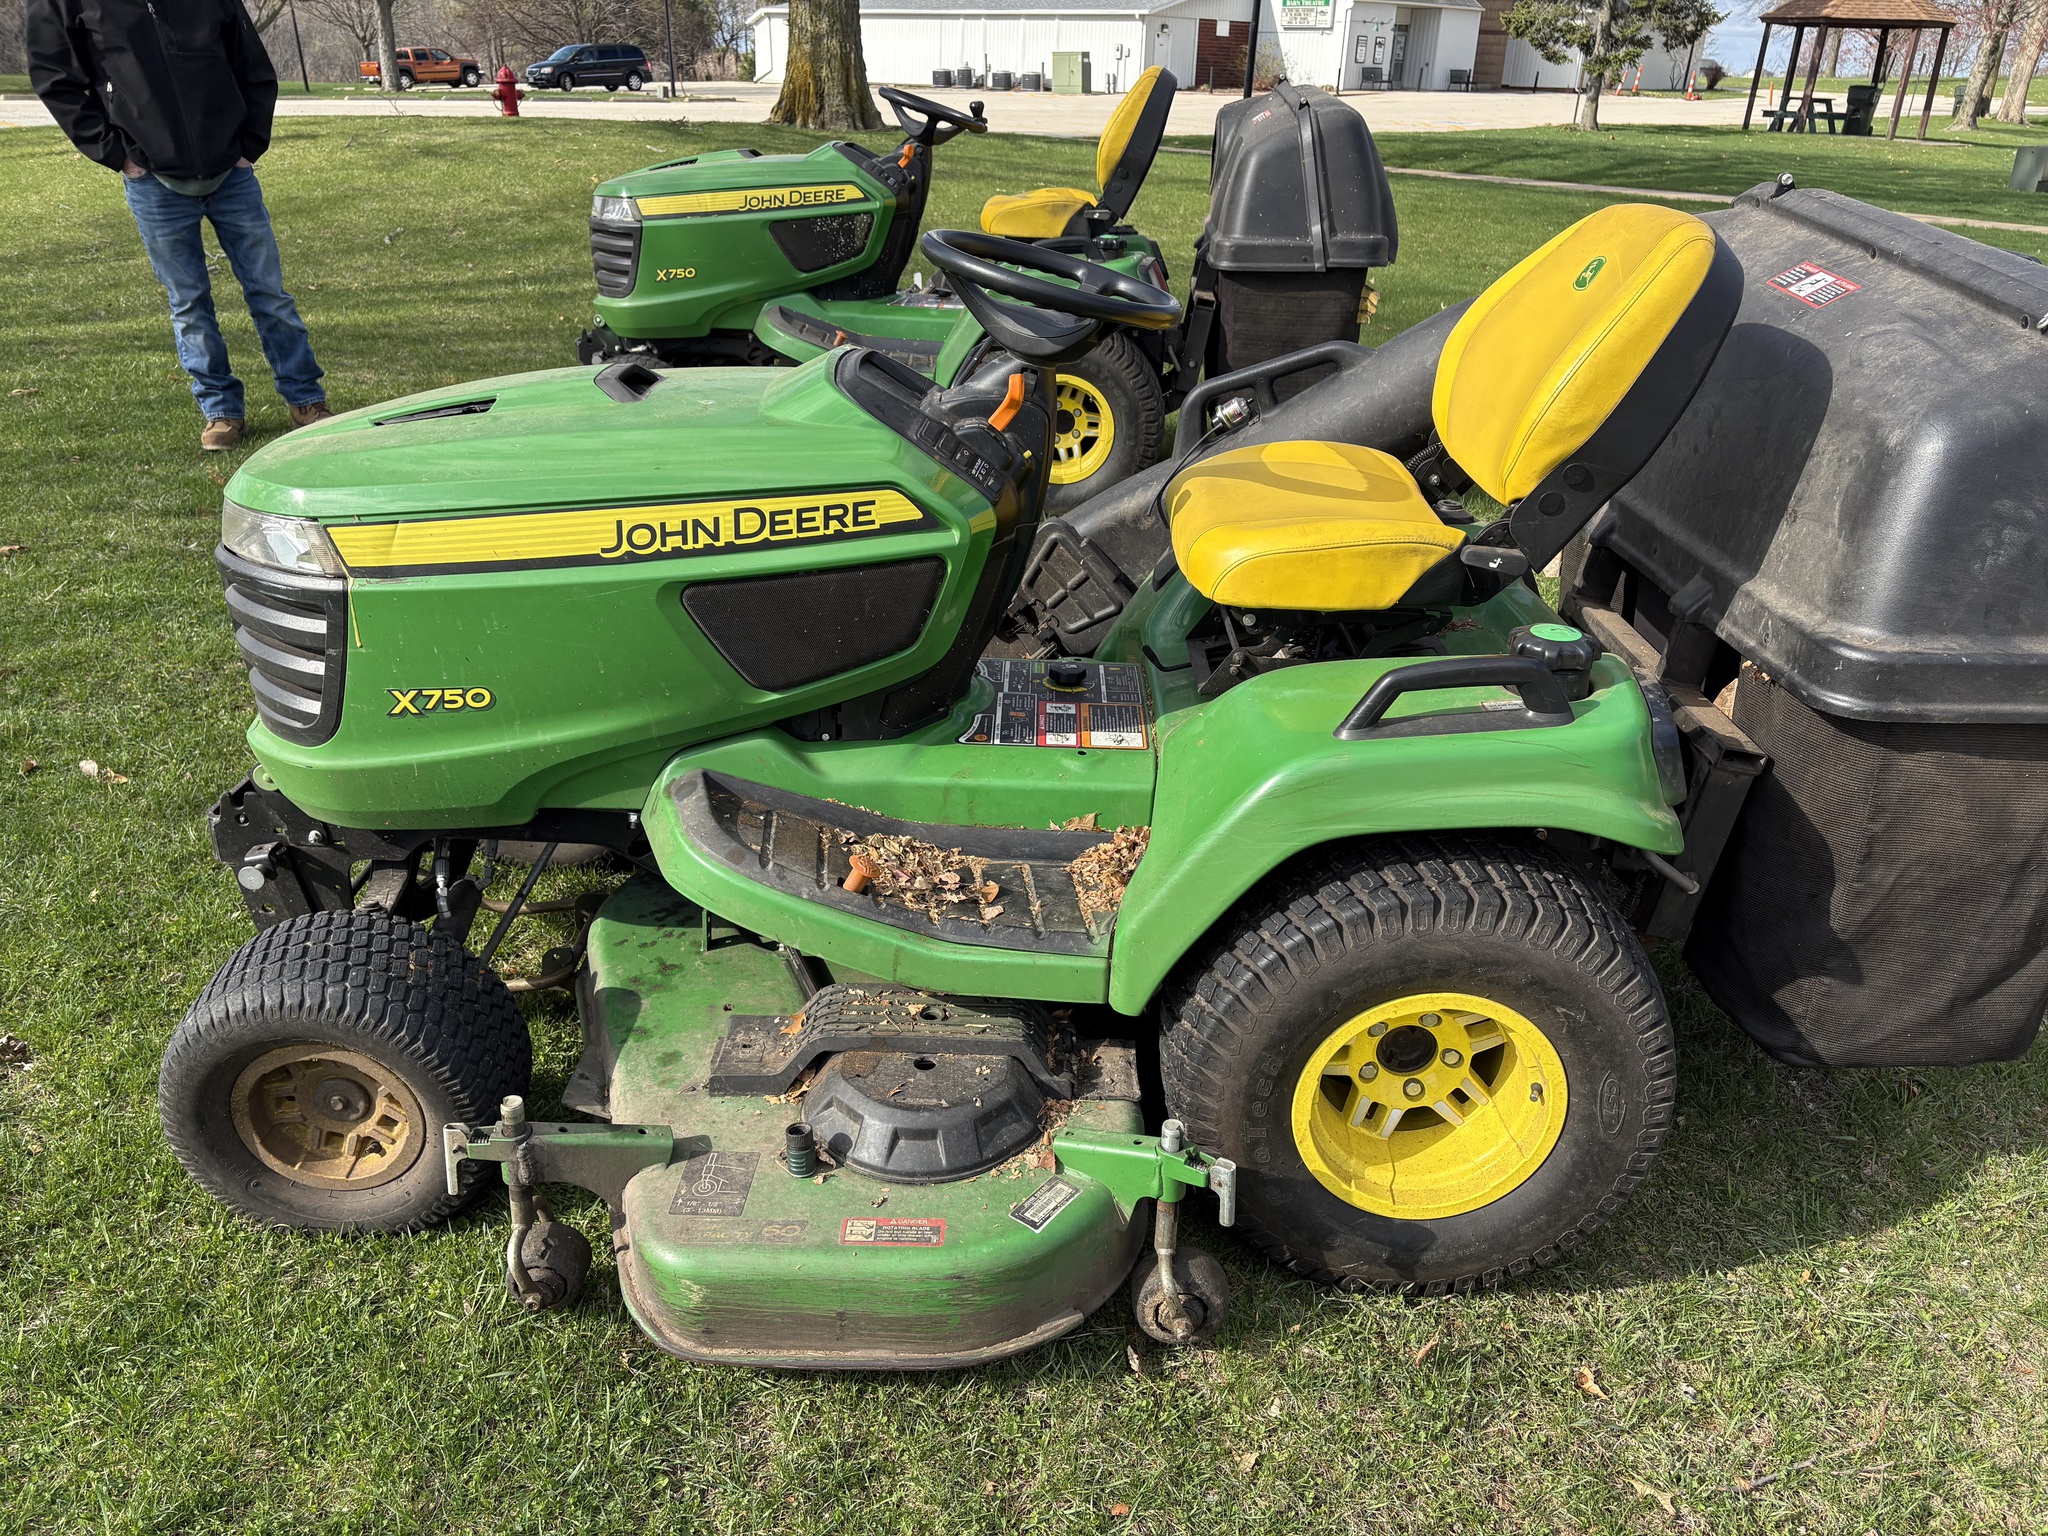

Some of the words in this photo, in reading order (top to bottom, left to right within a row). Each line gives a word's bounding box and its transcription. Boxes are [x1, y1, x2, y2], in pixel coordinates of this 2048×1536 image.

[738, 194, 785, 212] JOHN
[789, 188, 847, 205] DEERE
[655, 267, 697, 282] X750
[600, 516, 722, 554] JOHN
[732, 499, 878, 543] DEERE
[387, 688, 493, 717] X750
[761, 1225, 802, 1237] 60
